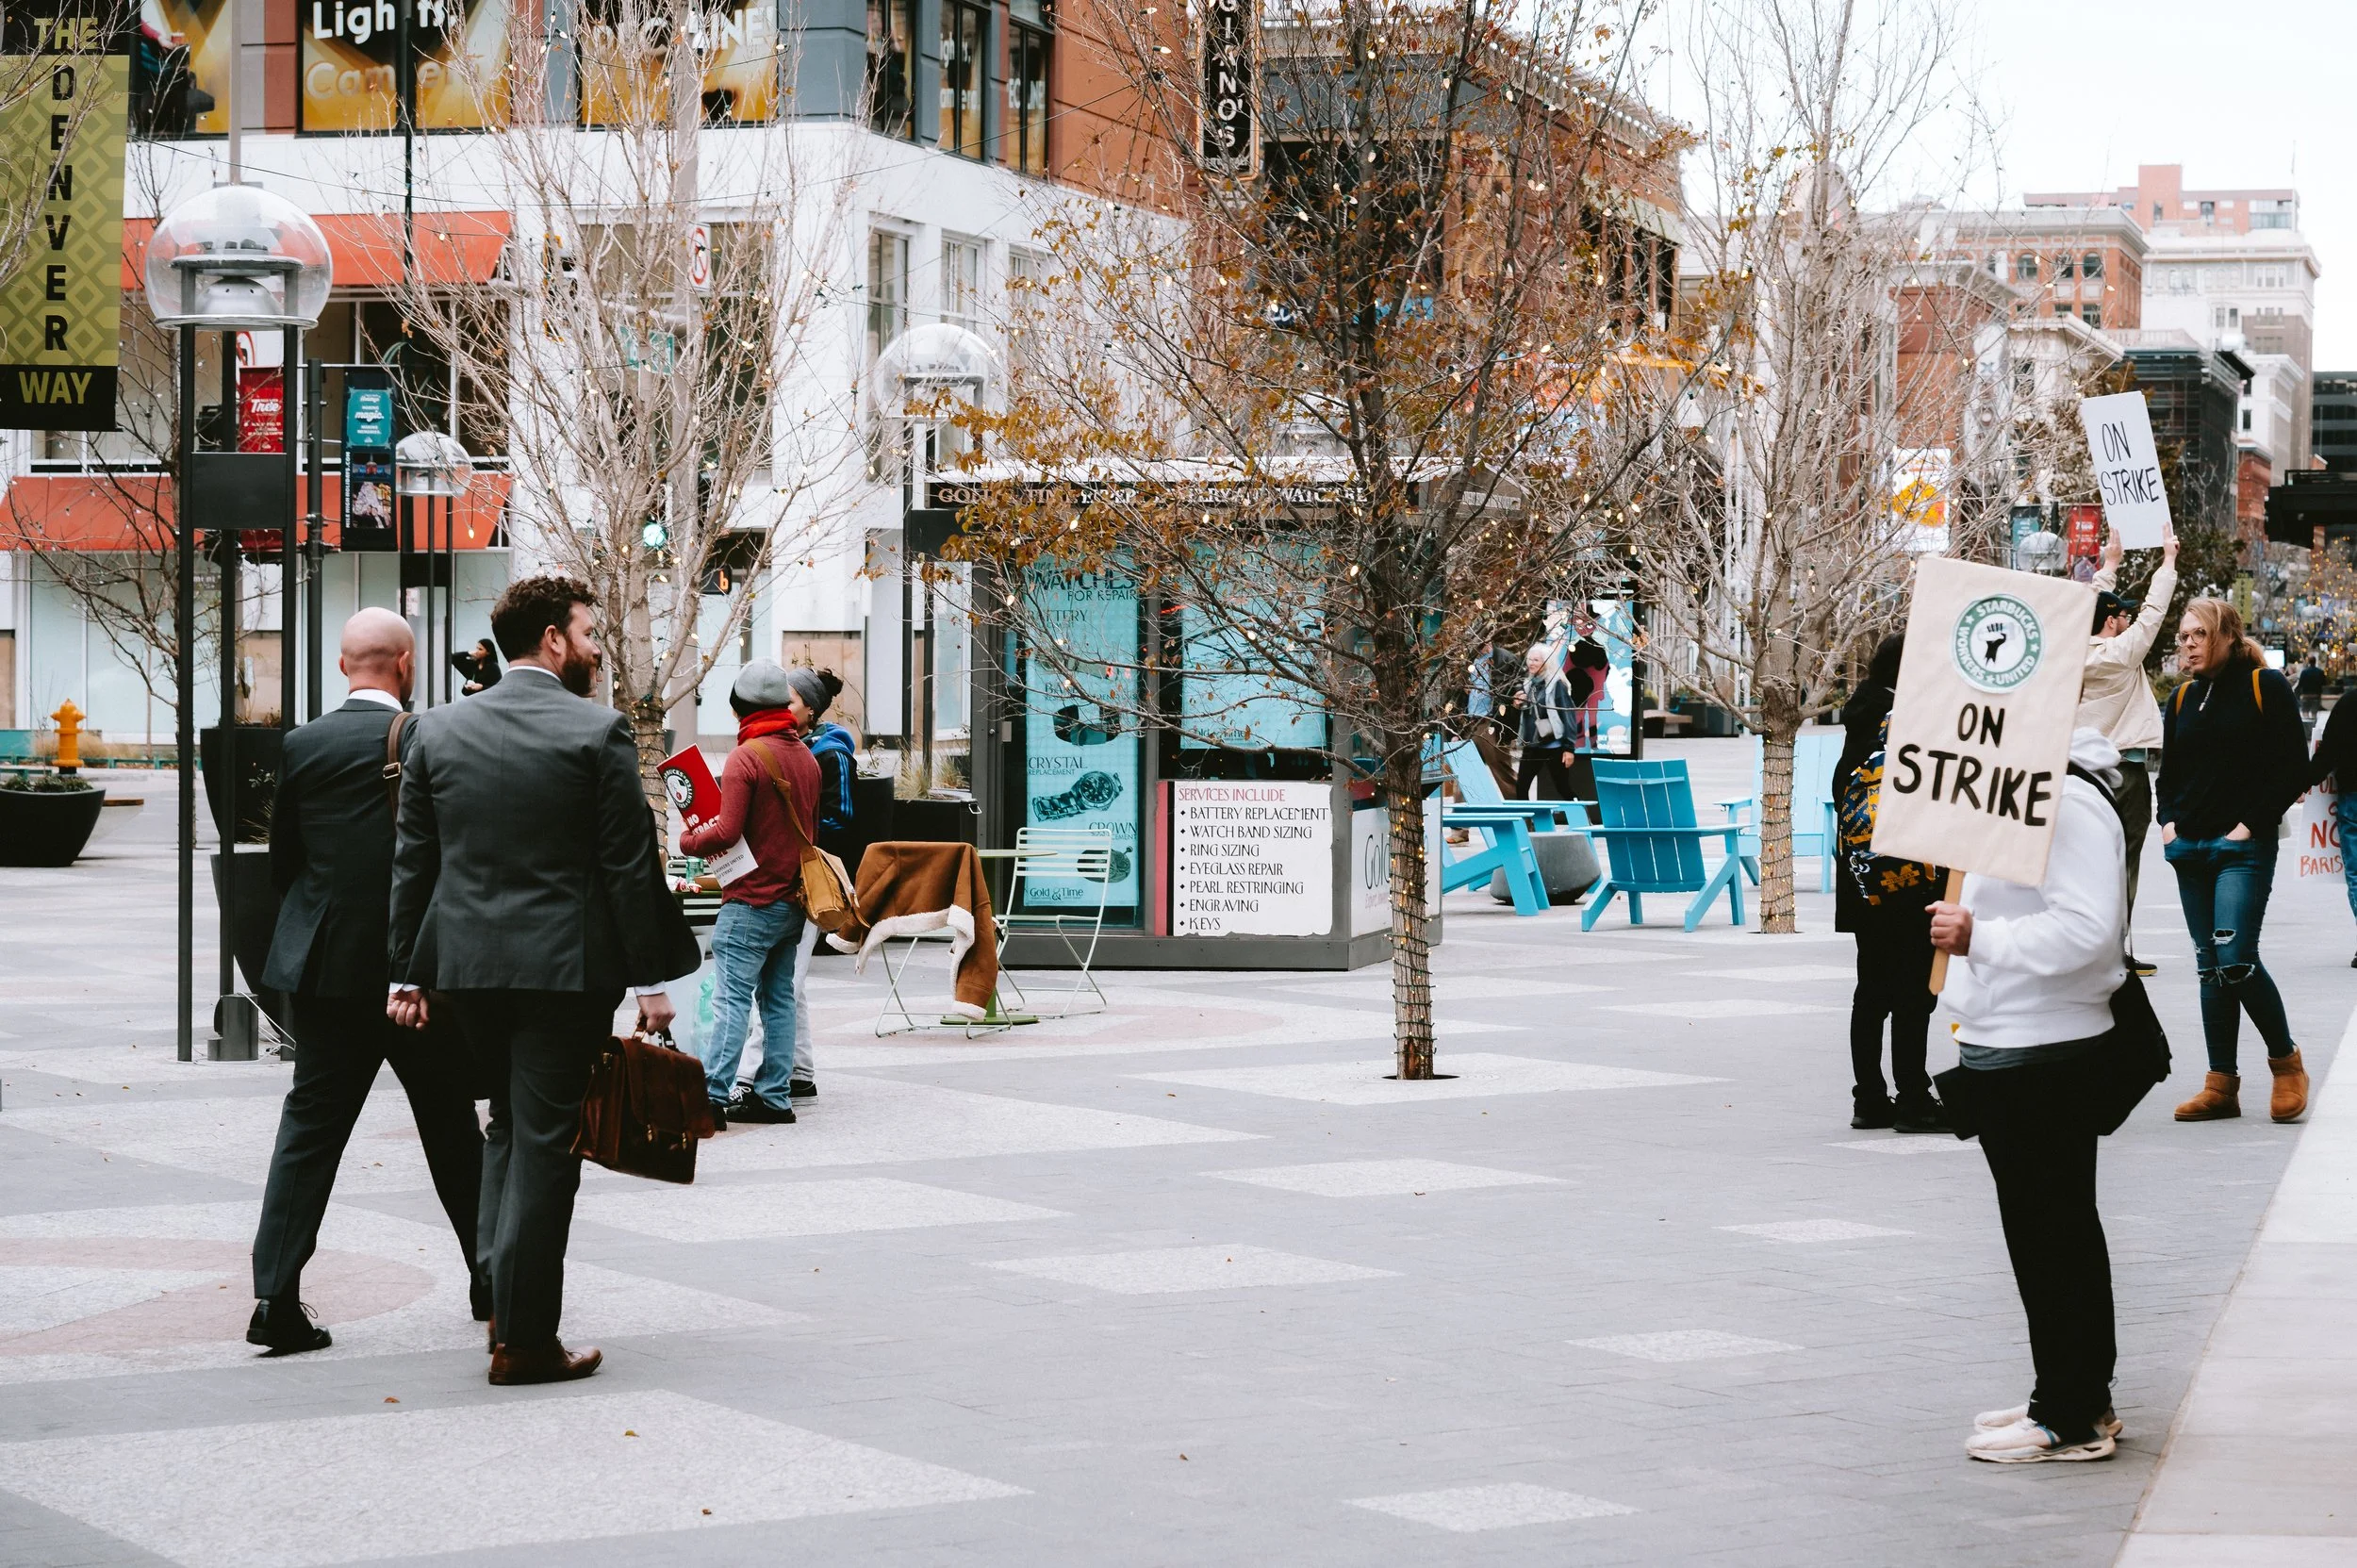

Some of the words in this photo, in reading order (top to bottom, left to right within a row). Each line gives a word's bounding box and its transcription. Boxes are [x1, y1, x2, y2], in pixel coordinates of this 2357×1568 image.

[34, 17, 98, 50] THE
[44, 65, 74, 351] DENVER
[19, 371, 92, 404] WAY
[2102, 421, 2132, 463] ON
[2101, 466, 2160, 506] STRIKE
[1067, 590, 1092, 602] FOR
[1097, 590, 1138, 602] REPAIR
[1029, 609, 1088, 622] BTTERY
[1975, 600, 2039, 640] STARBUCKS
[1956, 626, 1986, 680] WORKERS
[1995, 655, 2036, 685] UNITED
[1957, 702, 2005, 749] ON
[1029, 756, 1088, 769] CRYSTAL
[1893, 743, 2052, 827] STRIKE
[1178, 787, 1229, 801] SERVICES
[1232, 788, 1286, 801] INCLUDE
[1190, 806, 1243, 820] BATTERY
[1245, 807, 1328, 820] REPLACEMENT
[686, 814, 700, 828] NO
[1089, 821, 1137, 834] CROWN
[1190, 825, 1234, 838] WATCH
[1237, 825, 1271, 838] BAND
[1273, 826, 1312, 839] SIZING
[1190, 844, 1218, 857] RING
[1221, 844, 1260, 857] SIZING
[1190, 862, 1245, 875] EYEGLASS
[1248, 863, 1284, 876] REPAIR
[2299, 854, 2345, 878] BARIS
[1030, 887, 1050, 898] Gold
[1062, 886, 1084, 898] Time
[1190, 881, 1224, 894] PEARL
[1227, 881, 1304, 895] RESTRINGING
[1189, 899, 1259, 913] ENGRAVING
[1189, 917, 1221, 930] KEYS
